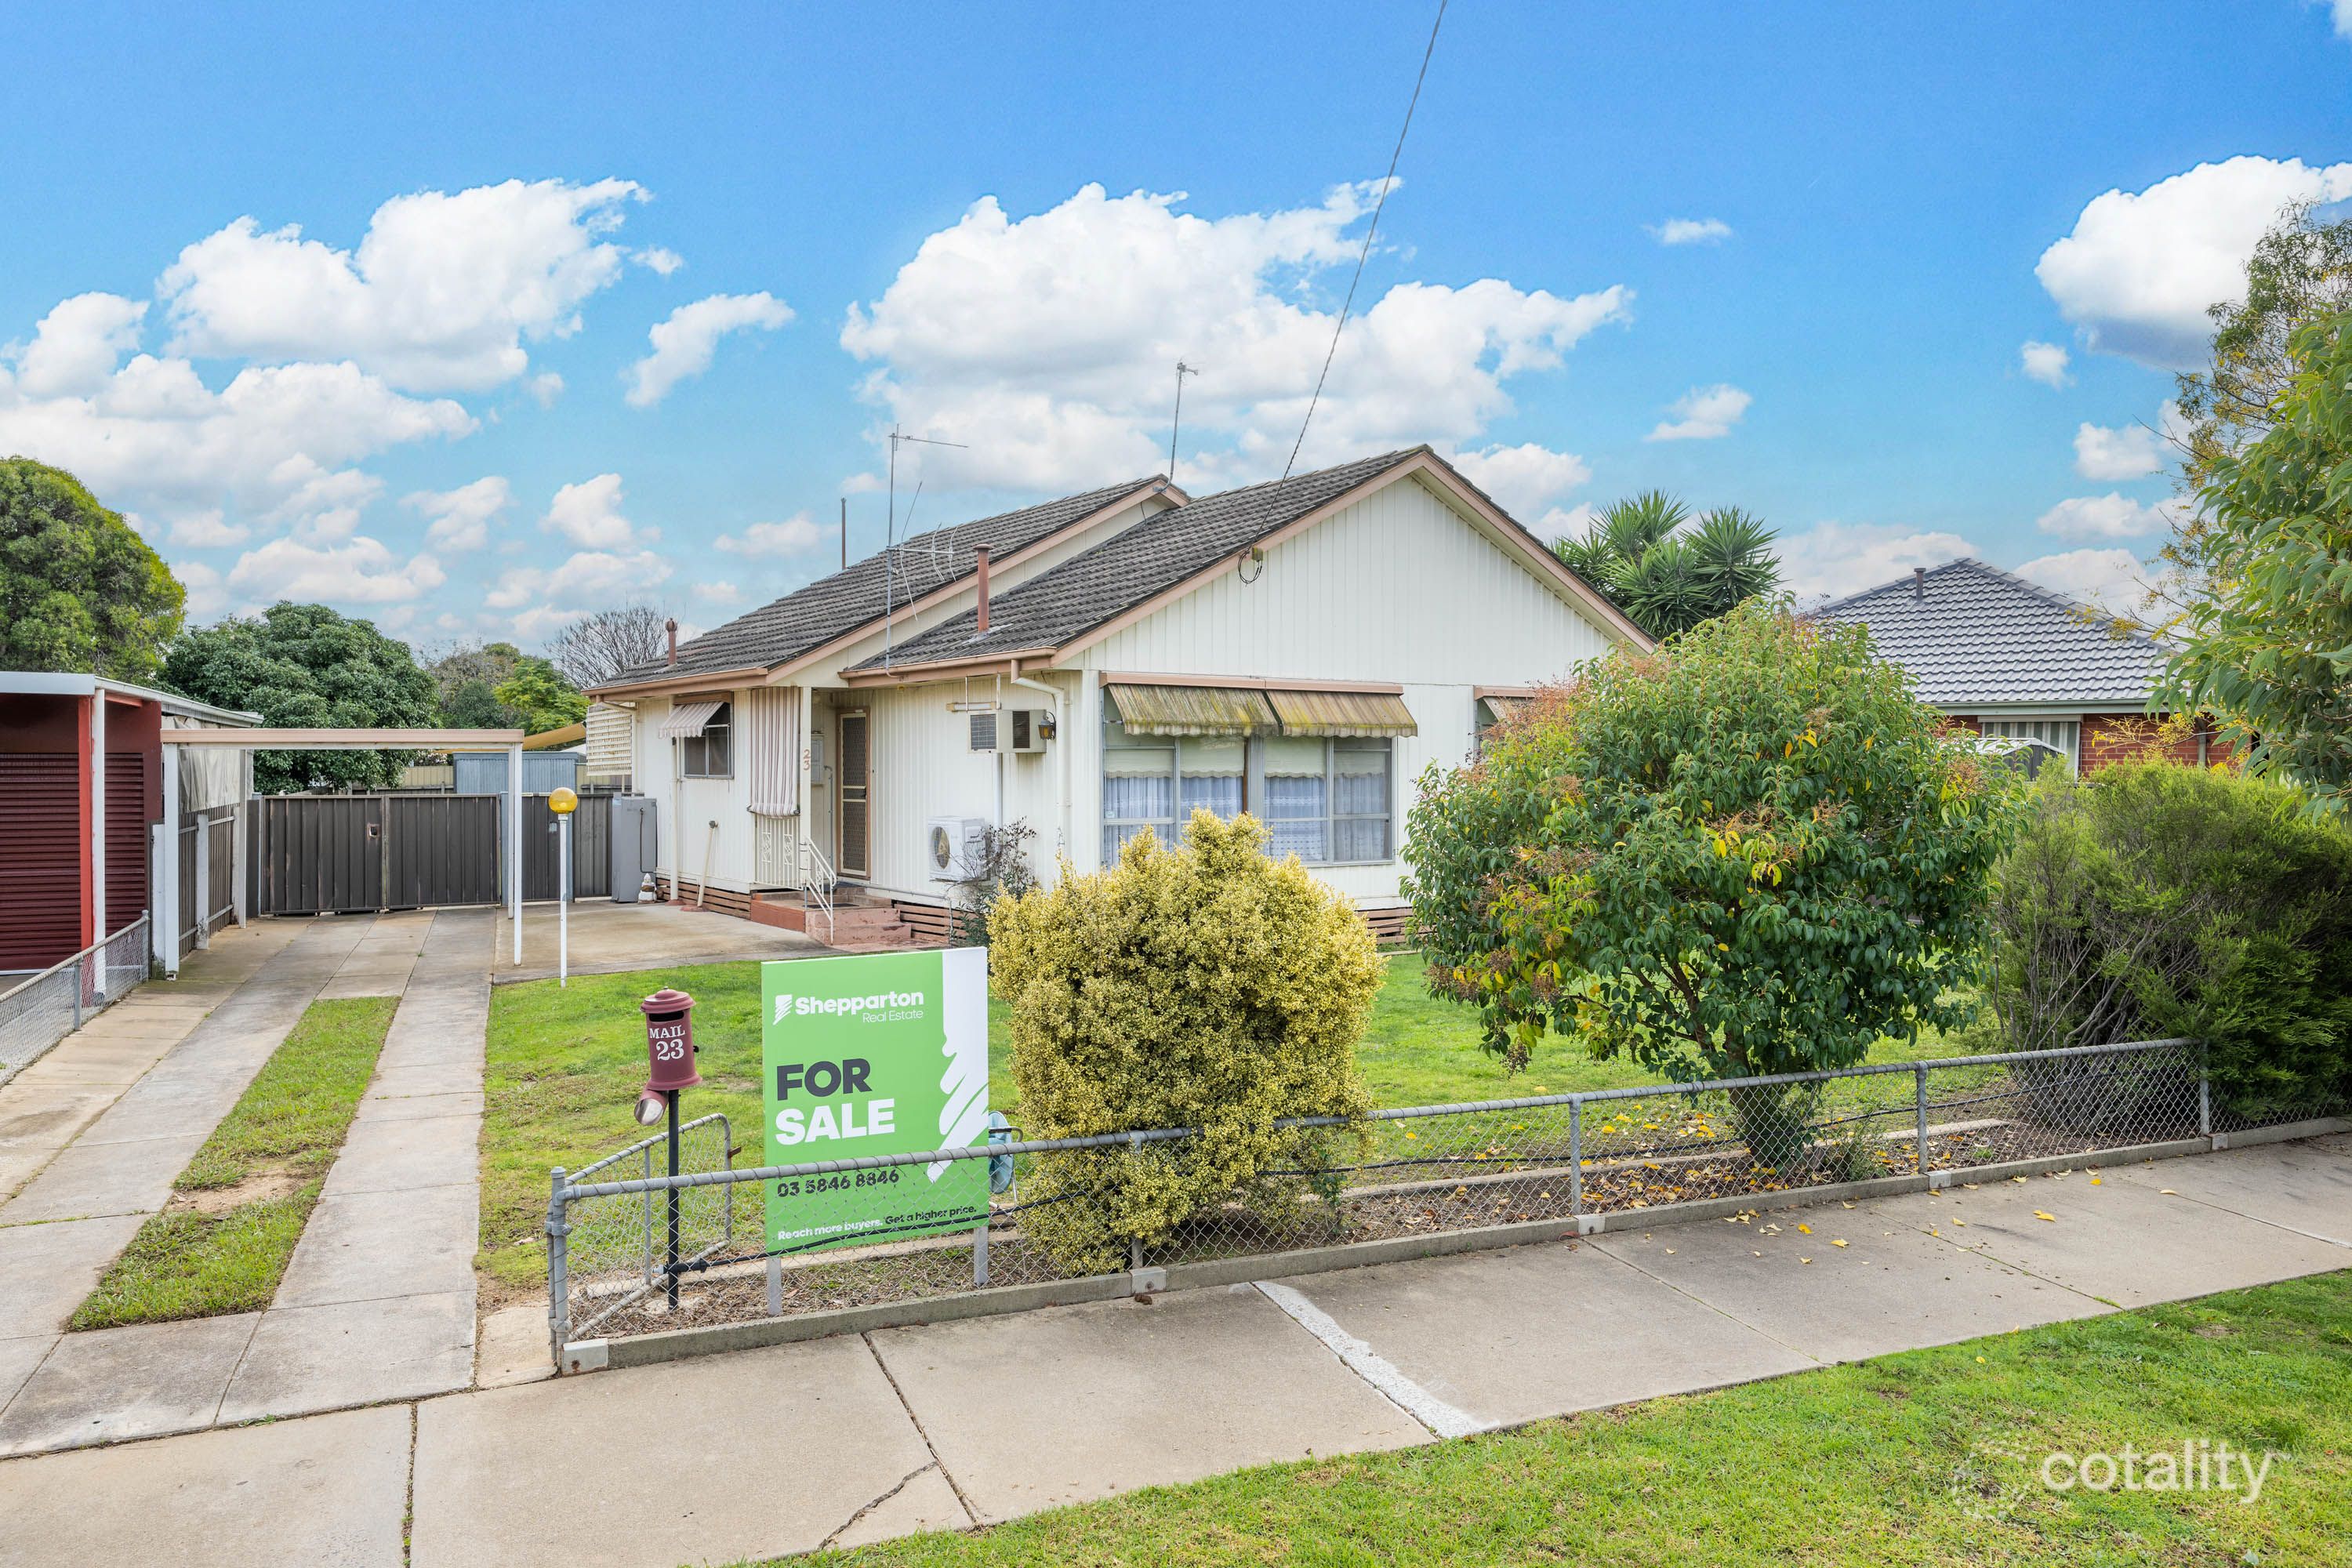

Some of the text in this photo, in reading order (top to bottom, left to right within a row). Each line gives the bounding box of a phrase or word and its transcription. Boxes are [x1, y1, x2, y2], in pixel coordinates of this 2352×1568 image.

[795, 991, 924, 1016] Shepparton
[862, 1009, 924, 1023] Real Estate
[649, 1025, 685, 1039] MAIL
[656, 1039, 684, 1061] 23
[776, 1058, 873, 1101] FOR
[775, 1098, 895, 1145] SALE
[777, 1169, 899, 1198] 03 5846 8846
[778, 1229, 813, 1240] Reach
[815, 1225, 843, 1236] more
[844, 1218, 884, 1232] buyers.
[885, 1214, 904, 1225] Get
[915, 1209, 947, 1223] higher
[949, 1205, 977, 1218] price.
